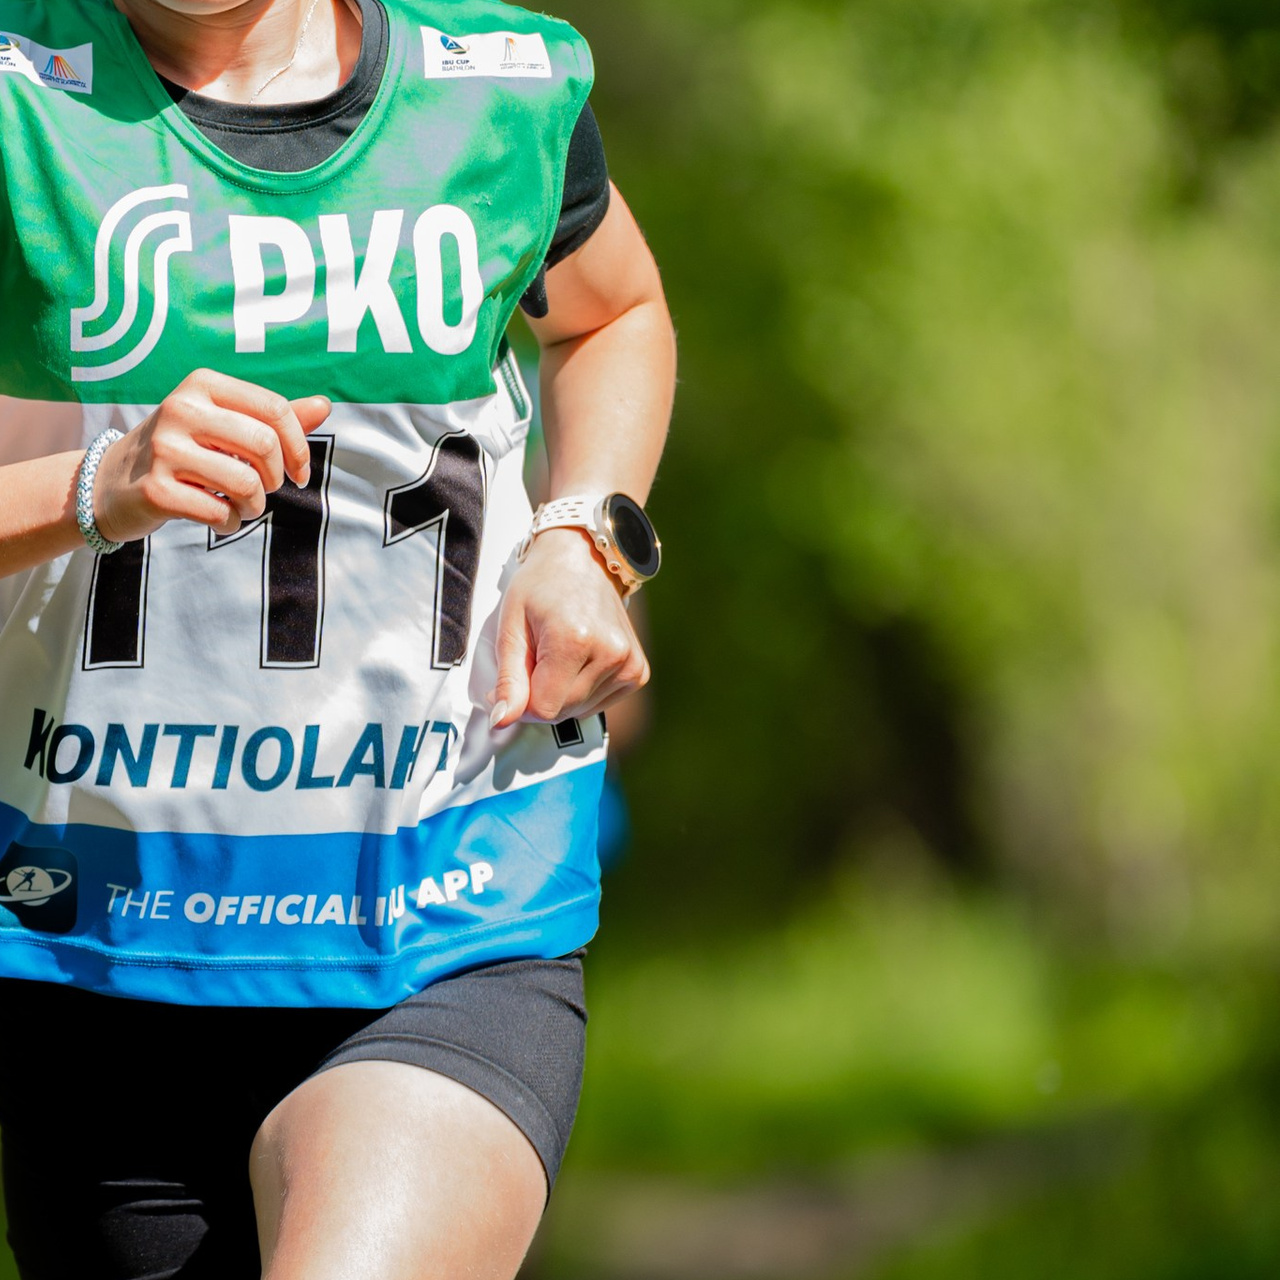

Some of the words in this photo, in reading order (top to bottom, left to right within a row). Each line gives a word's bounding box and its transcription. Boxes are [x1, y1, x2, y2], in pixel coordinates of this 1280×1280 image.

[229, 204, 483, 355] PKO
[106, 883, 174, 920] THE
[184, 892, 367, 926] OFFICIAL
[417, 862, 494, 909] APP
